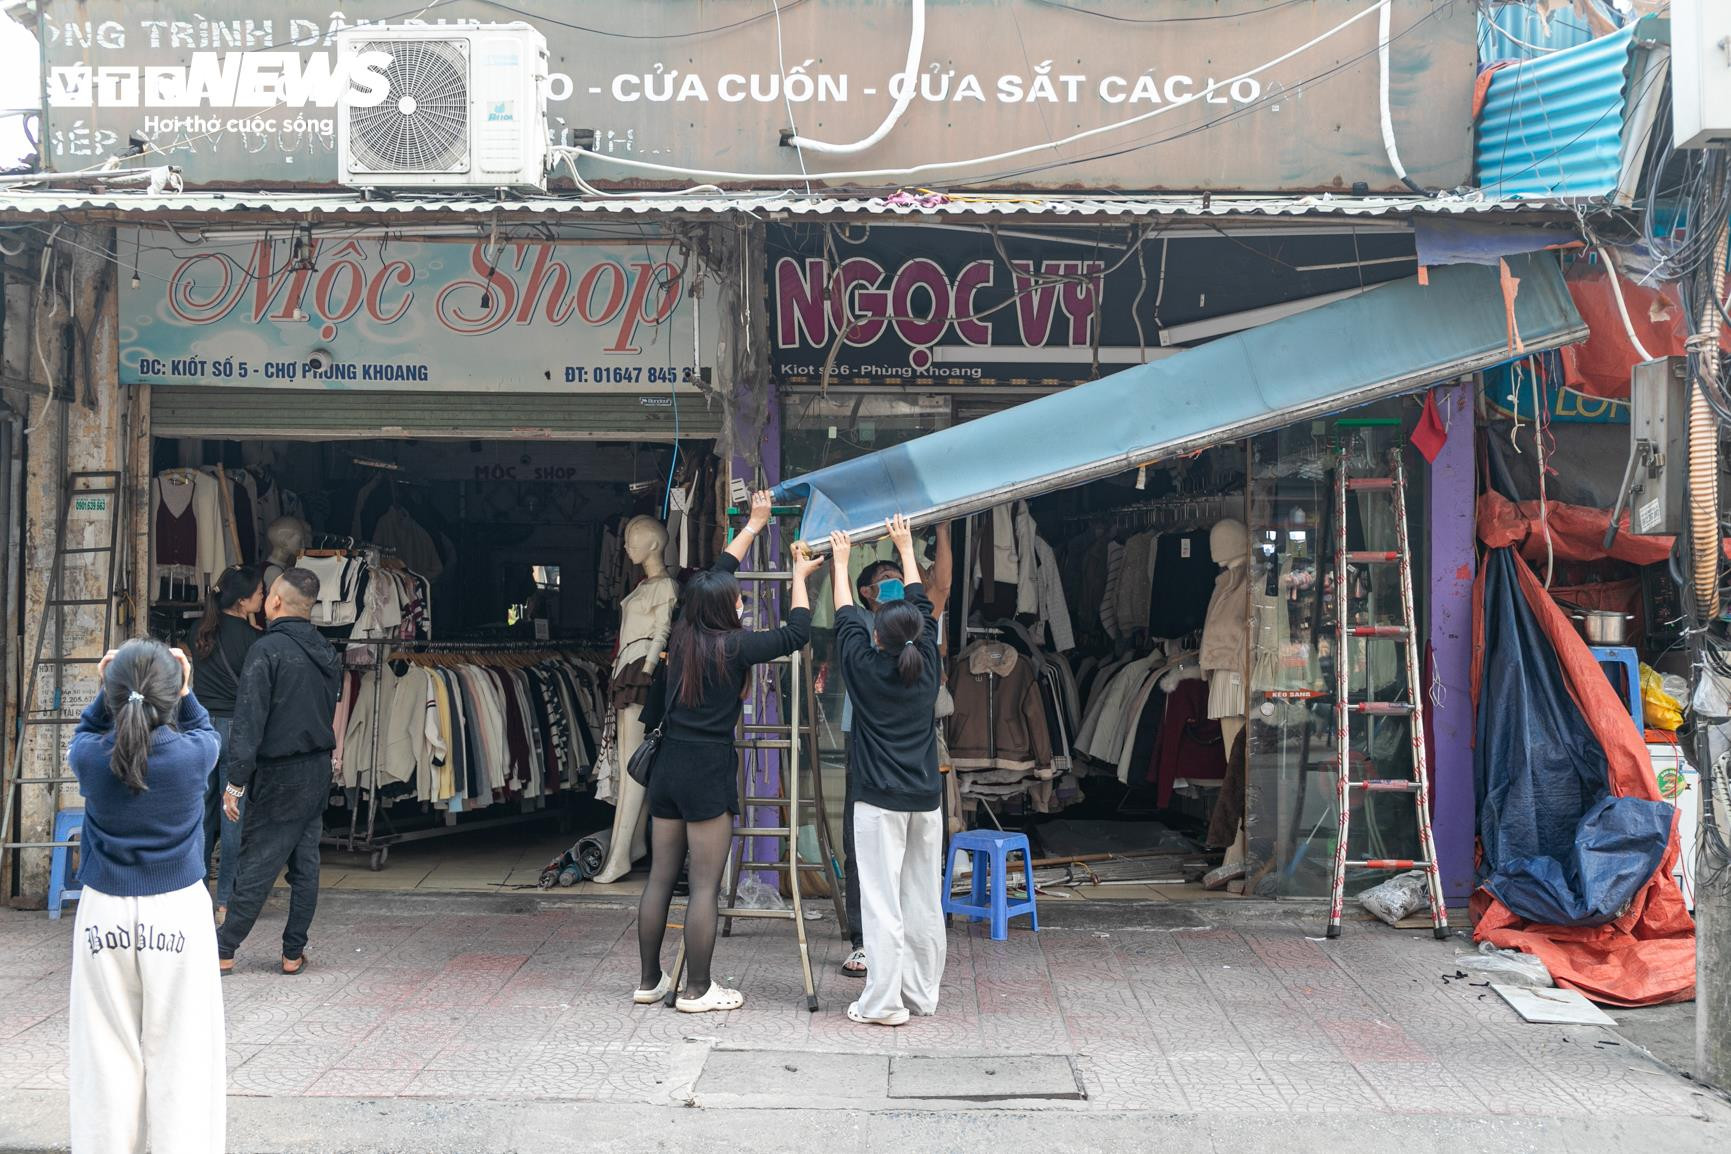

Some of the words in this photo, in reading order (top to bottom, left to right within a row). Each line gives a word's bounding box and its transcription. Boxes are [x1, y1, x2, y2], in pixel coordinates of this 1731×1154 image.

[140, 13, 273, 48] TRÌNH
[611, 62, 709, 102] CỬA
[717, 58, 848, 103] CUỐN
[888, 62, 986, 102] CỬA
[996, 59, 1087, 103] SẮT
[1099, 67, 1194, 104] CÁC
[168, 241, 417, 343] Mộc
[435, 244, 684, 356] Shop
[774, 256, 995, 370] NGỌC
[1011, 259, 1106, 348] VY
[139, 358, 167, 376] ĐC:
[171, 353, 207, 377] KIỐT
[212, 354, 233, 378] SỐ
[238, 361, 248, 378] 5
[264, 360, 297, 382] CHỢ
[362, 363, 429, 382] KHOANG
[564, 366, 589, 383] ĐT:
[593, 366, 643, 383] 01647
[647, 366, 678, 383] 845
[780, 363, 815, 375] Kiot
[860, 364, 913, 378] Phùng
[916, 365, 982, 378] Khoang
[533, 465, 577, 480] SHOP
